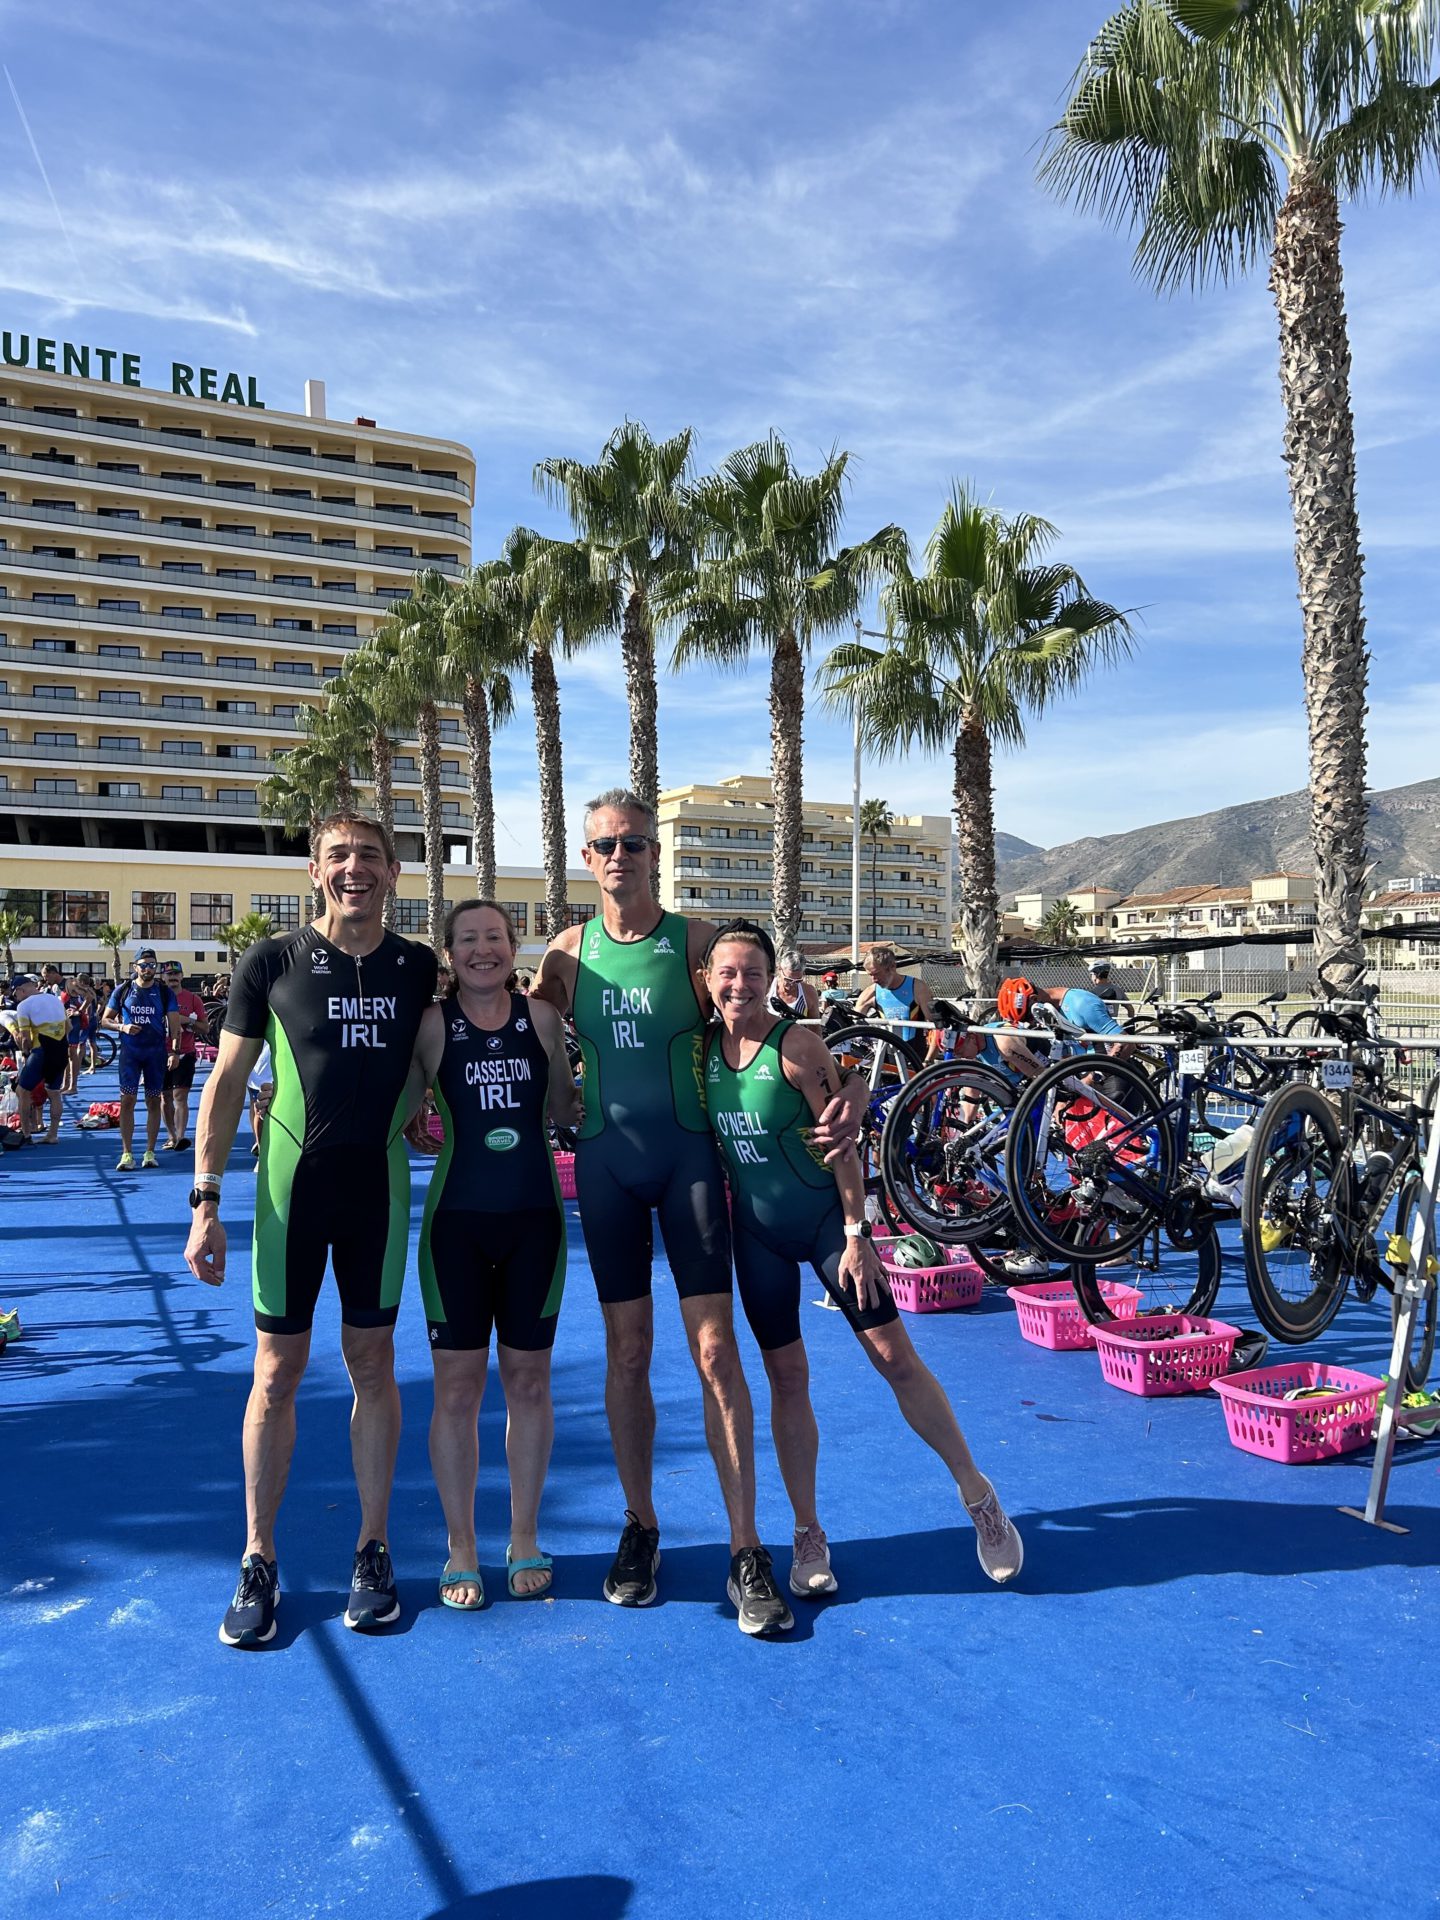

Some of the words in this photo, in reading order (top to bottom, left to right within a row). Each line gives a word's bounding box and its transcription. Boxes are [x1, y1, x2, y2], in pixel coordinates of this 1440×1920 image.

[2, 331, 141, 387] UENTE
[171, 361, 265, 409] REAL
[130, 1005, 156, 1015] ROSEN
[328, 996, 397, 1019] EMERY
[602, 987, 652, 1016] FLACK
[134, 1016, 151, 1024] USA
[341, 1023, 387, 1048] IRL
[612, 1020, 645, 1048] IRL
[1179, 1053, 1204, 1063] 134B
[1323, 1064, 1351, 1076] 134A
[465, 1058, 531, 1085] CASSELTON
[479, 1083, 521, 1110] IRL
[717, 1111, 769, 1137] O'NEILL
[733, 1140, 769, 1164] IRL
